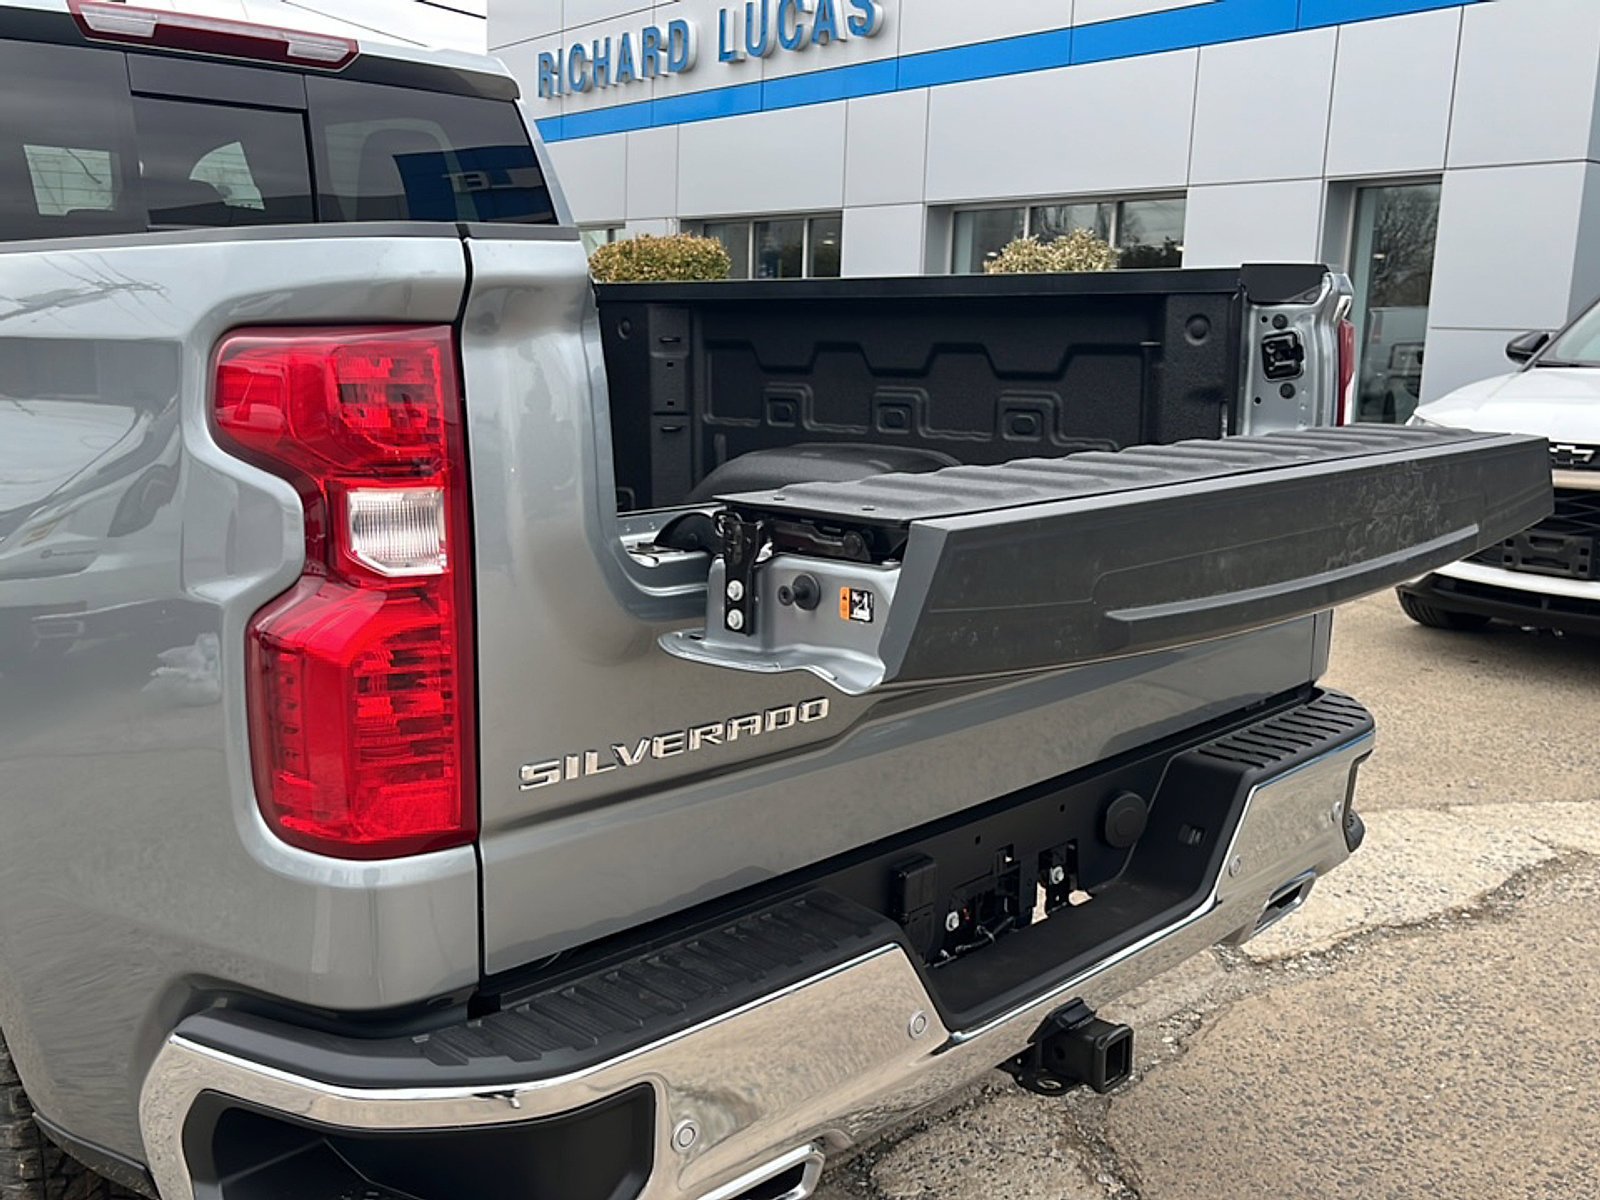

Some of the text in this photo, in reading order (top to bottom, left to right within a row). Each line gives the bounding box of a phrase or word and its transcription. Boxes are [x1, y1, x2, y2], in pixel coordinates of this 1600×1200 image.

[538, 0, 883, 98] RICHARD LUCAS
[519, 697, 830, 791] SILVERADO
